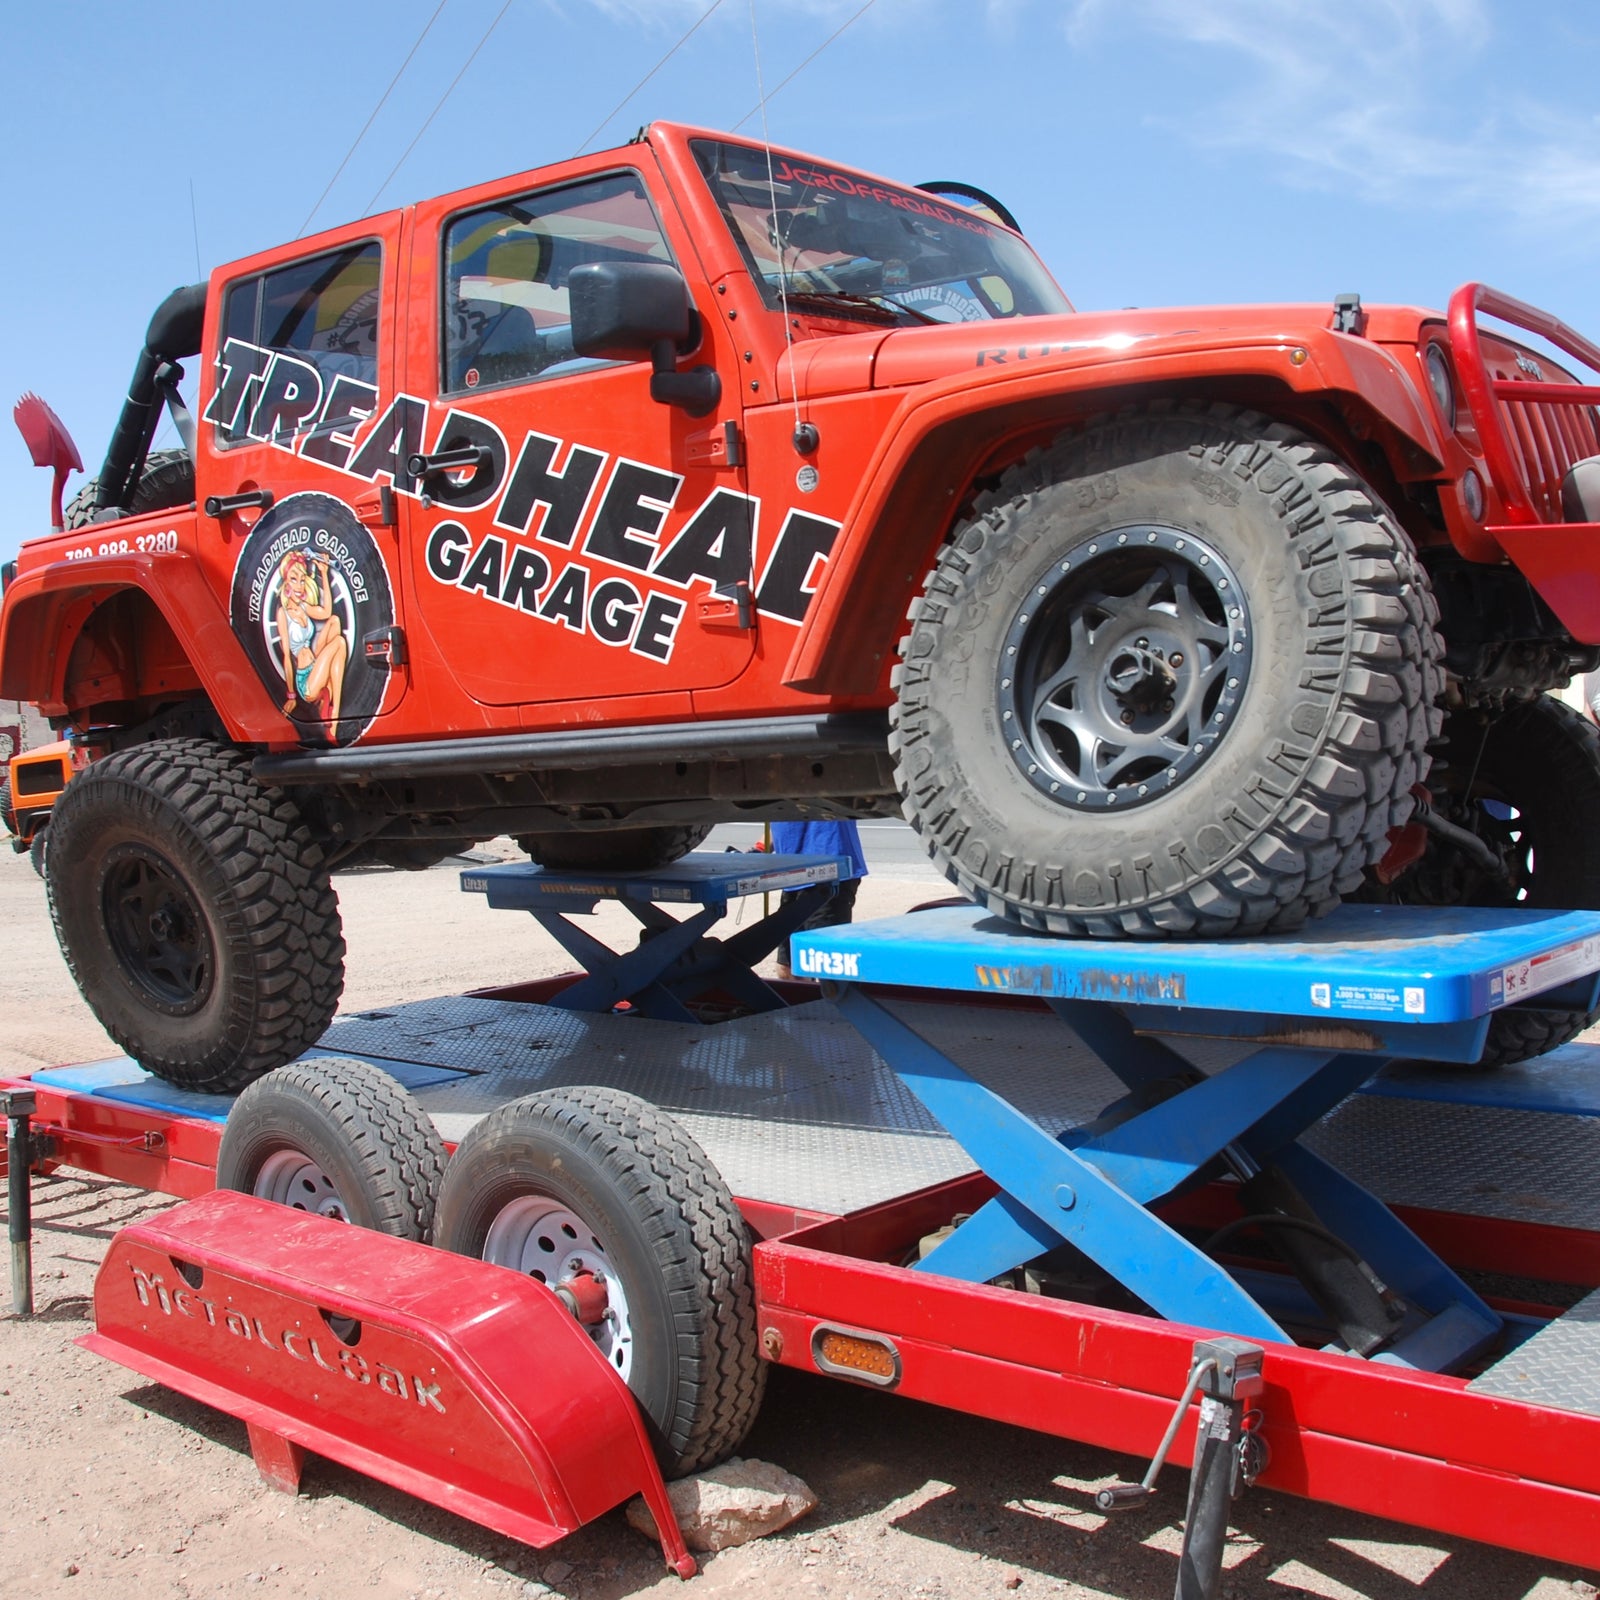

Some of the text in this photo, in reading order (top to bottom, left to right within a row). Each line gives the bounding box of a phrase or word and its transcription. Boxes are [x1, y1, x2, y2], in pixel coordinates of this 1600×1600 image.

[202, 336, 844, 627] TREADHEAD
[249, 526, 369, 622] TREADHEAD GARAGE
[425, 519, 688, 665] GARAGE
[800, 948, 860, 977] Lift3K
